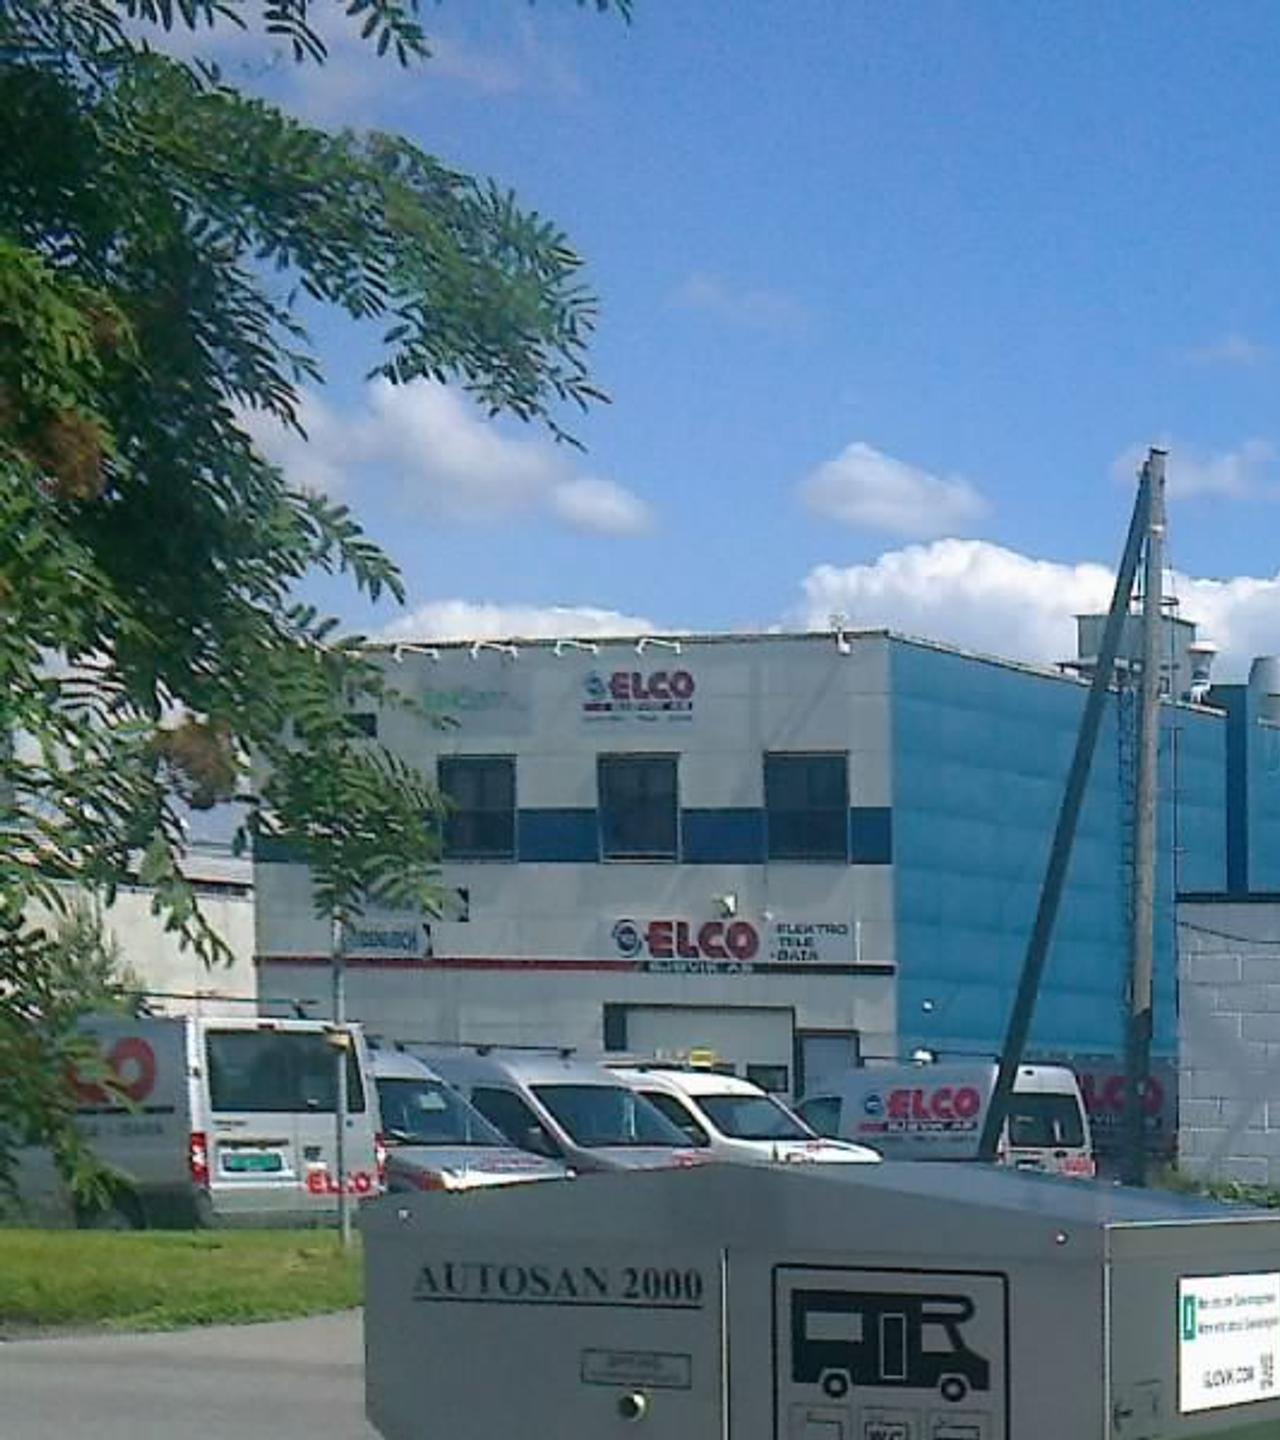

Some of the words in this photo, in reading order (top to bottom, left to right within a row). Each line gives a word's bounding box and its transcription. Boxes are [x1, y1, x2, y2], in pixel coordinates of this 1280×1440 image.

[609, 671, 695, 699] ELCO
[645, 921, 760, 960] ELCO
[776, 923, 848, 936] ELEKTRO
[779, 937, 814, 948] TELE
[887, 1087, 980, 1120] ELCO
[413, 1262, 608, 1297] AUTOSAN
[622, 1267, 703, 1299] 2000
